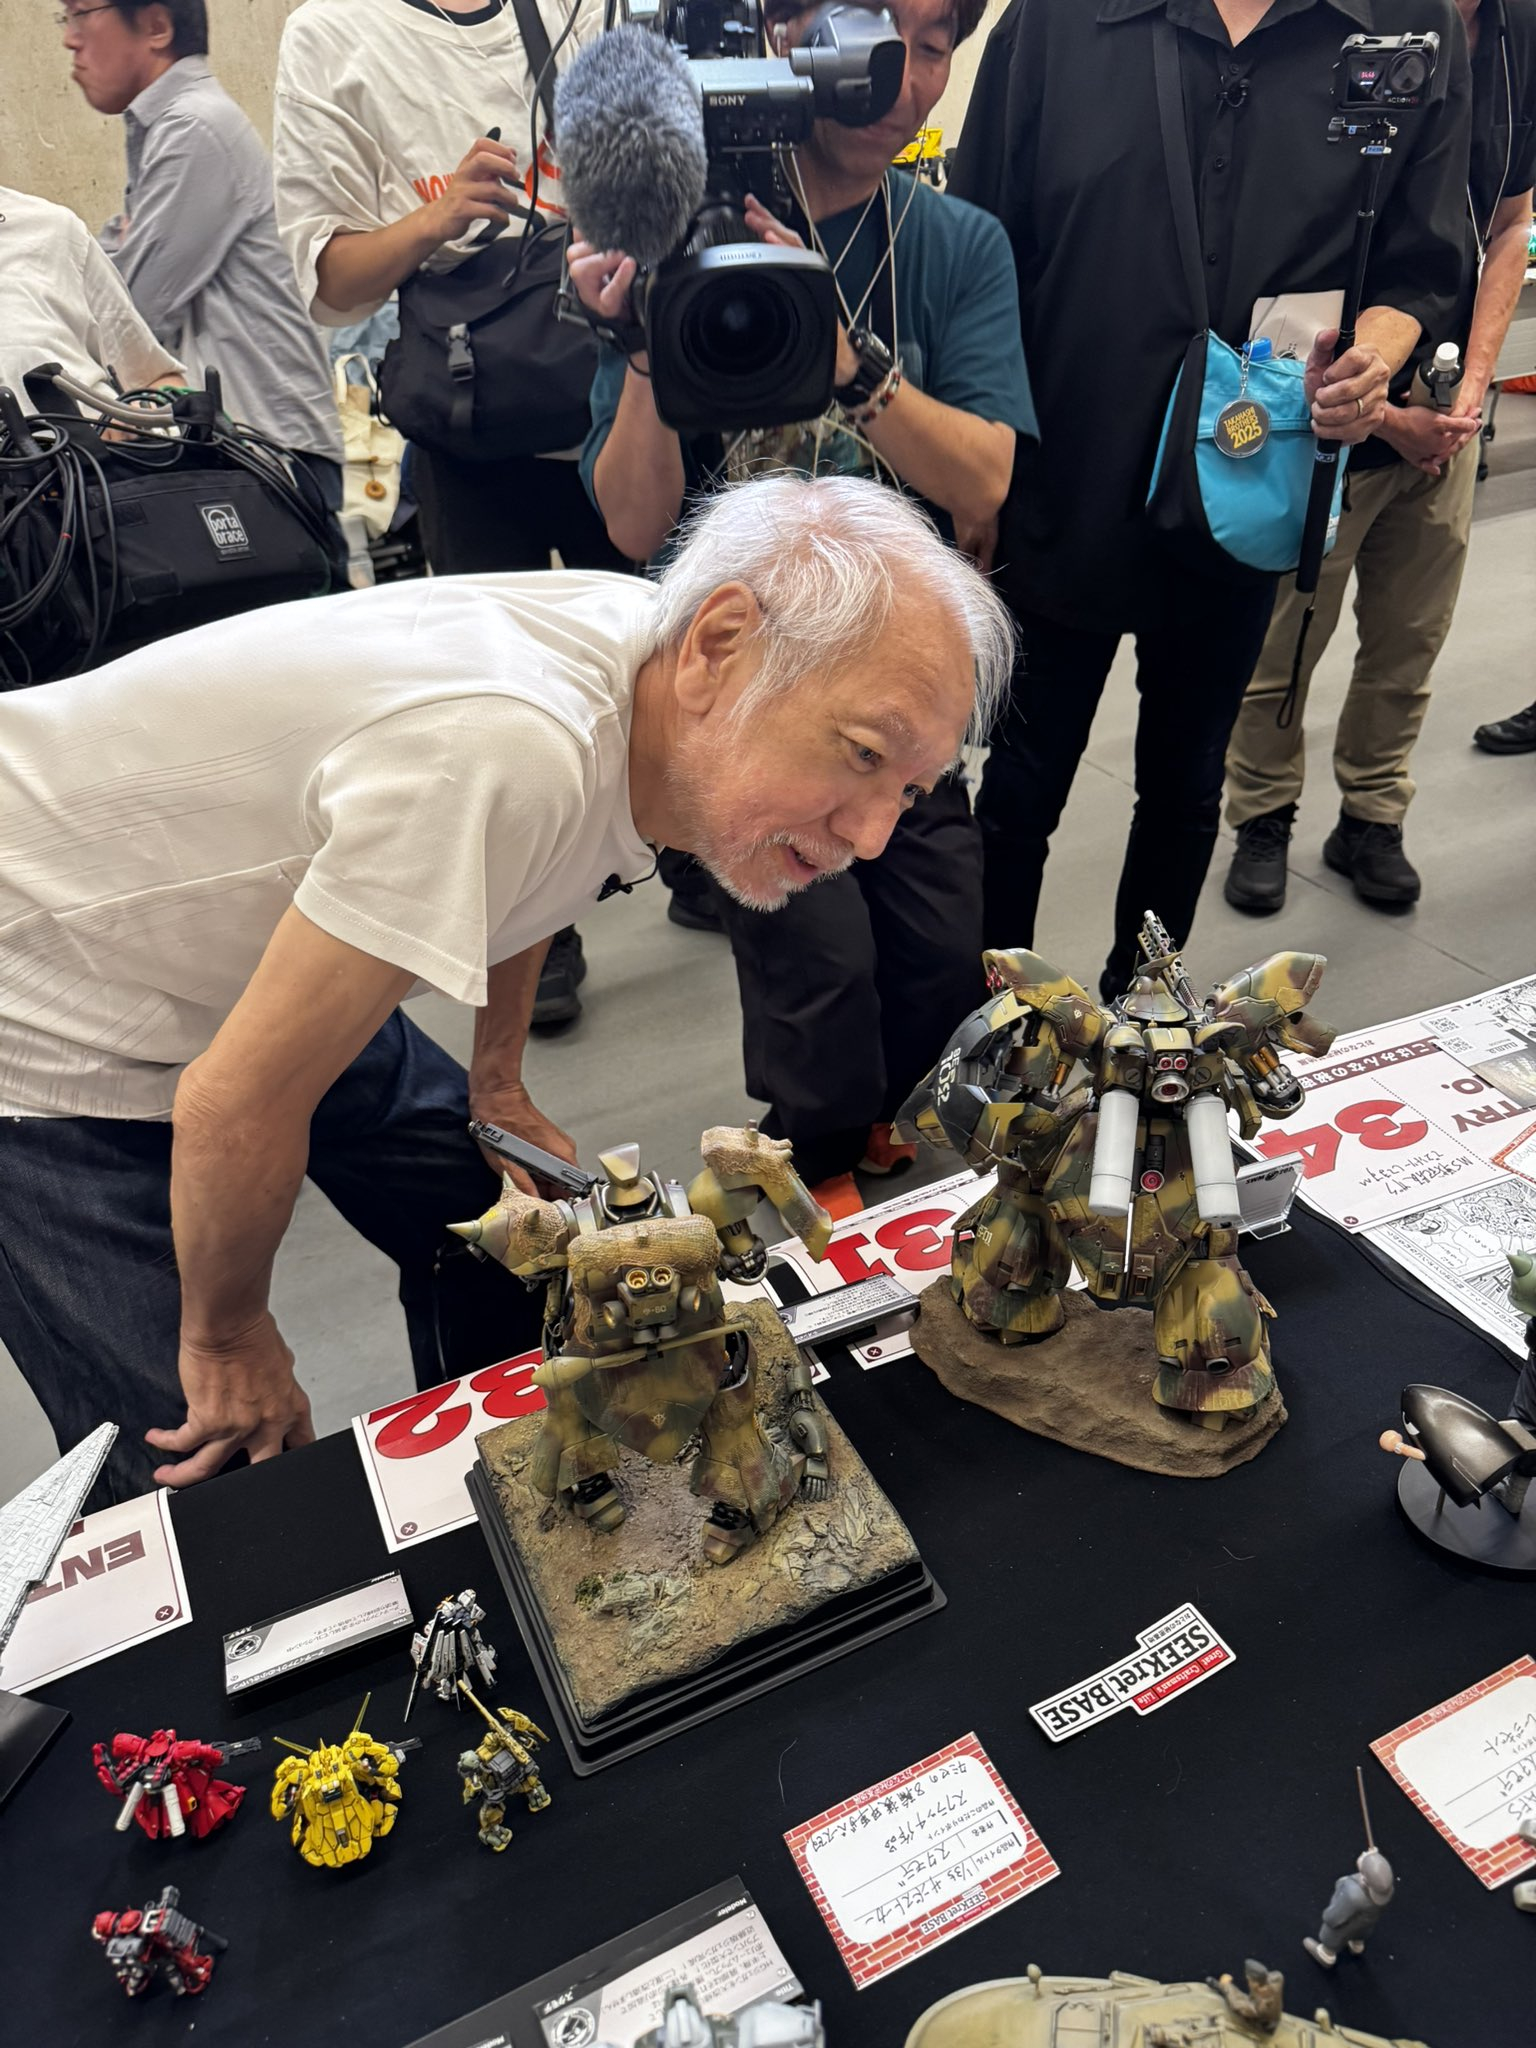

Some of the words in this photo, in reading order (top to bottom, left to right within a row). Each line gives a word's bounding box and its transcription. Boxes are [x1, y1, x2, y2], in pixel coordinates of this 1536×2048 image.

[709, 95, 746, 106] SONY
[1230, 422, 1262, 449] 2025
[209, 513, 239, 531] porta
[214, 529, 245, 545] brace
[1255, 1099, 1428, 1179] 34
[821, 1208, 974, 1285] 31
[367, 1350, 547, 1459] 32
[1145, 1611, 1191, 1644] おとなの秘密基地
[1108, 1623, 1211, 1696] SEEKret
[1200, 1648, 1224, 1668] Great
[1154, 1662, 1200, 1695] Craftsman's
[1041, 1681, 1115, 1731] BASE
[1136, 1689, 1156, 1706] Life
[925, 1798, 996, 1841] 作品のこだわりポイント
[970, 1819, 994, 1837] 作者名
[974, 1838, 1016, 1866] 作品タイトル
[715, 1896, 747, 1918] Modeler
[946, 1889, 987, 1919] SEEKret
[919, 1911, 948, 1934] BASE
[774, 1982, 794, 1997] Title
